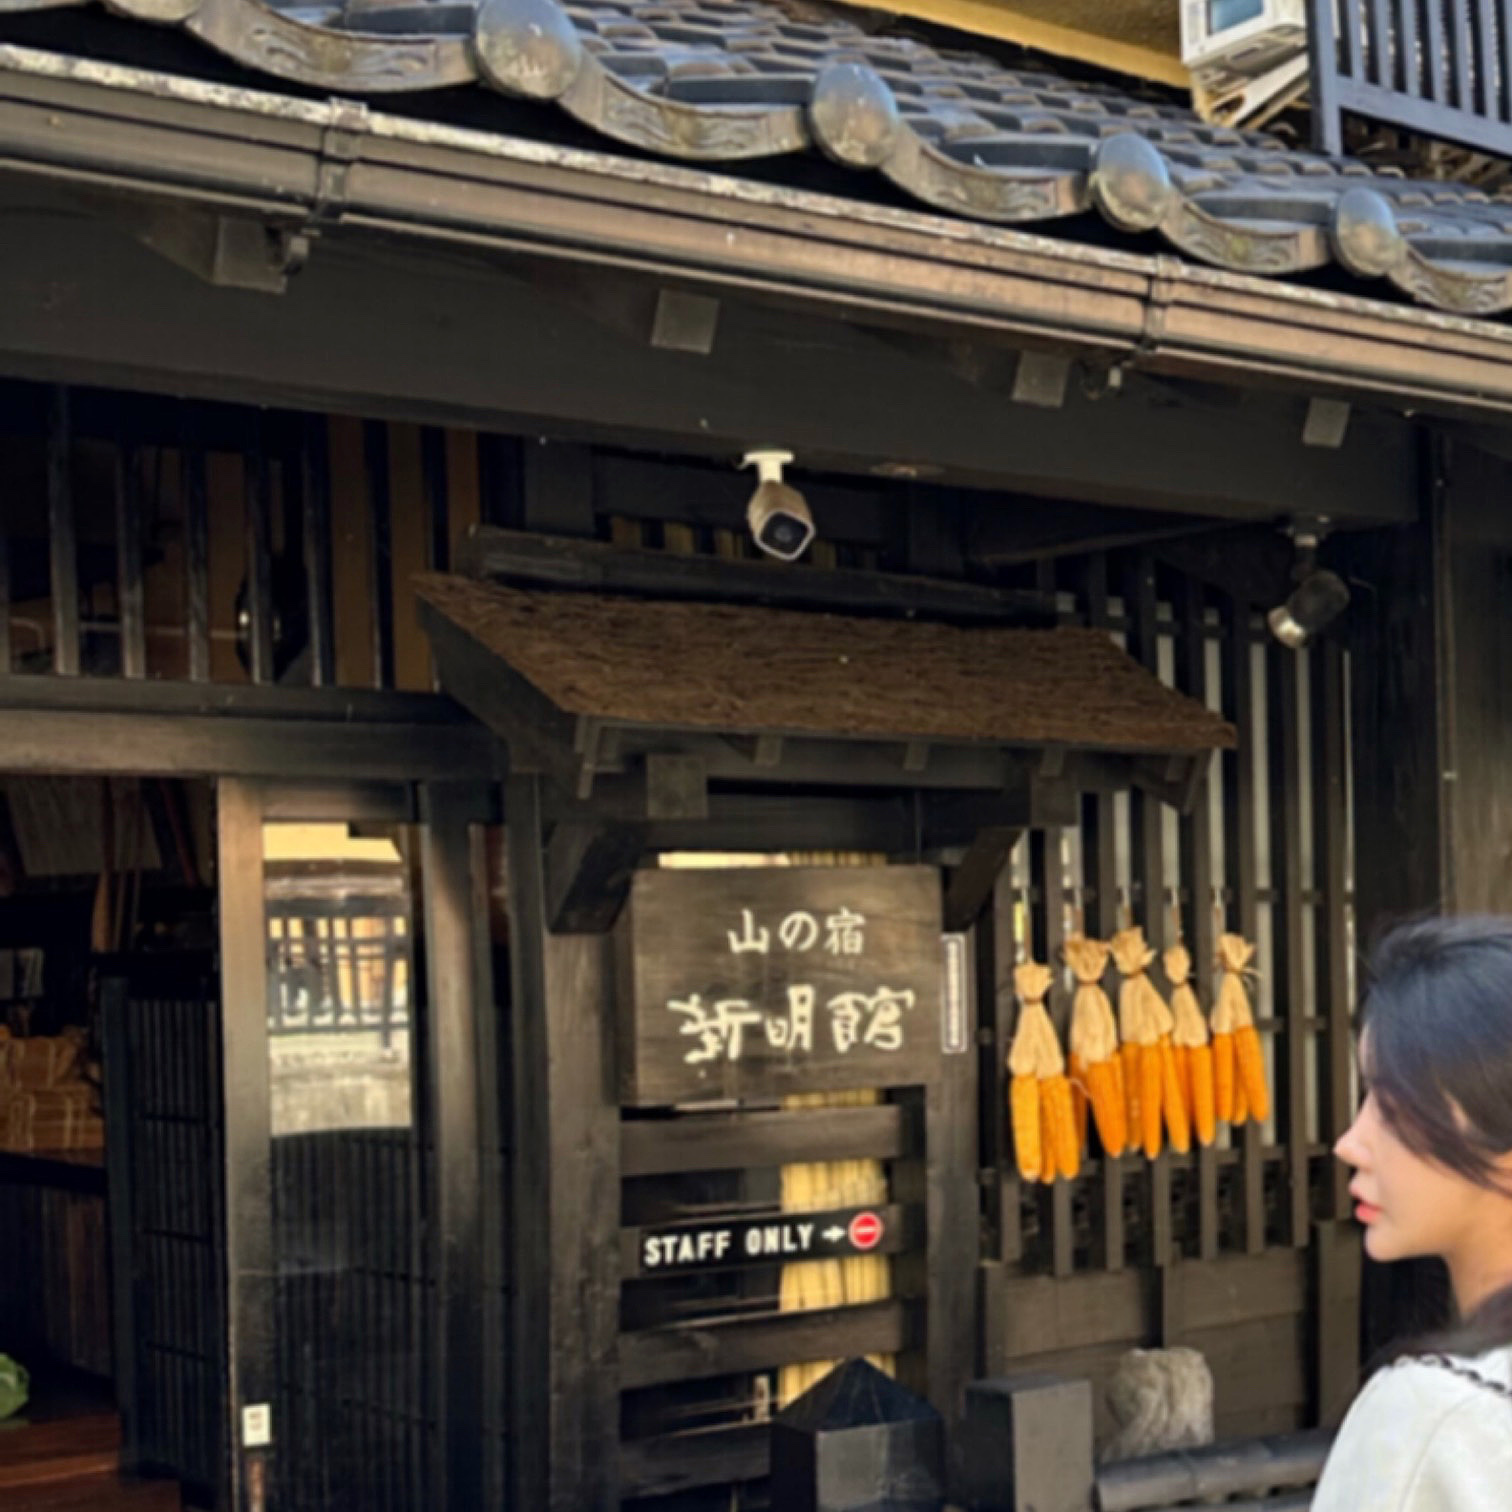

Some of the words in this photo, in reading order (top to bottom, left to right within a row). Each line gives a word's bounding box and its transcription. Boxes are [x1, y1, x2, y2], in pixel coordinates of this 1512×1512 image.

[728, 907, 866, 954] 山の宿
[667, 984, 915, 1063] 新明館
[644, 1230, 731, 1267] STAFF
[744, 1223, 814, 1256] ONLY
